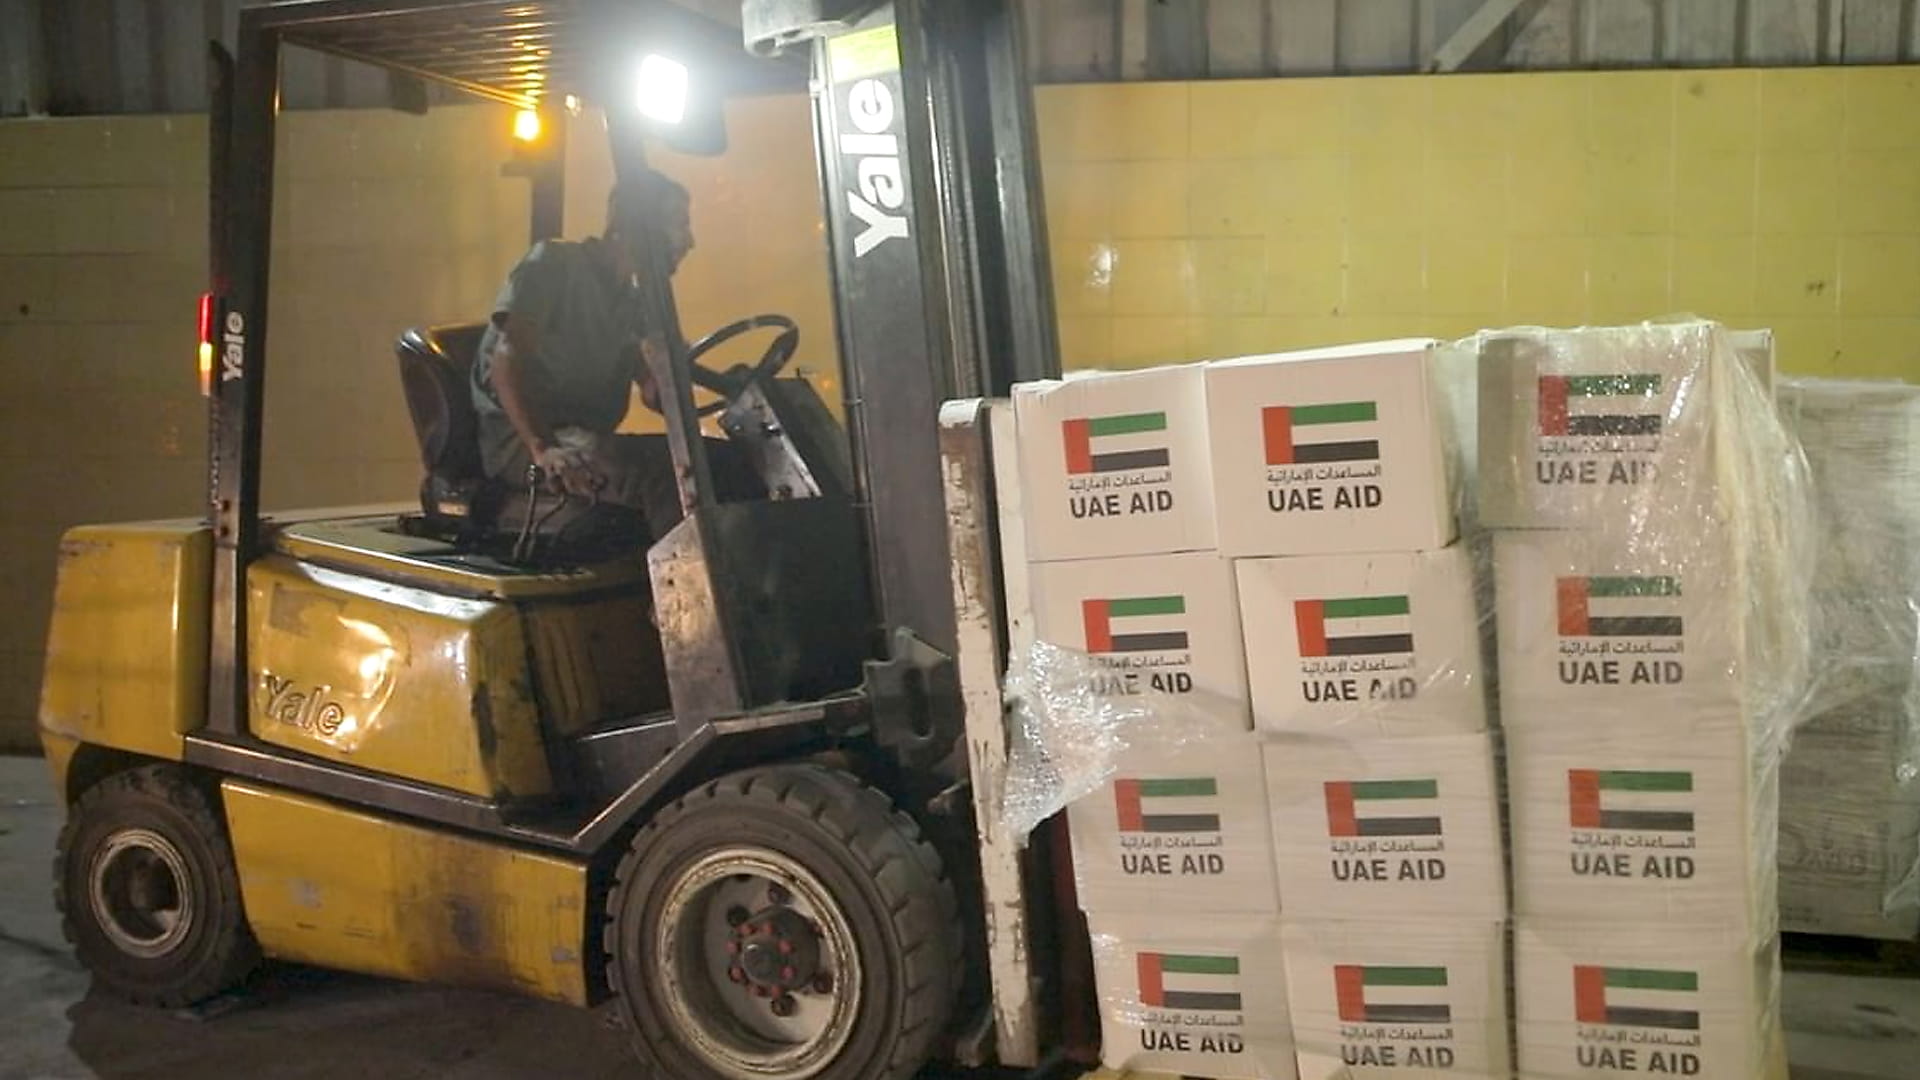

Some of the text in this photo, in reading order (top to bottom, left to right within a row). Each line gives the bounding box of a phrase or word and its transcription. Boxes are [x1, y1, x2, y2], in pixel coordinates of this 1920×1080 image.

[840, 78, 909, 257] Yale
[222, 310, 246, 382] Yale
[1536, 461, 1598, 484] UAE
[1070, 490, 1172, 518] UAE AID
[1268, 485, 1382, 511] UAE AID
[1090, 672, 1193, 695] UAE AID
[1558, 660, 1684, 684] UAE AID
[1302, 677, 1418, 702] UAE AID
[263, 674, 345, 735] Yale
[1121, 853, 1225, 874] UAE AID
[1331, 858, 1446, 881] UAE AID
[1571, 852, 1696, 878] UAE AID
[1141, 1028, 1244, 1053] UAE AID
[1340, 1044, 1455, 1069] UAE AID
[1576, 1045, 1701, 1075] UAE AID
